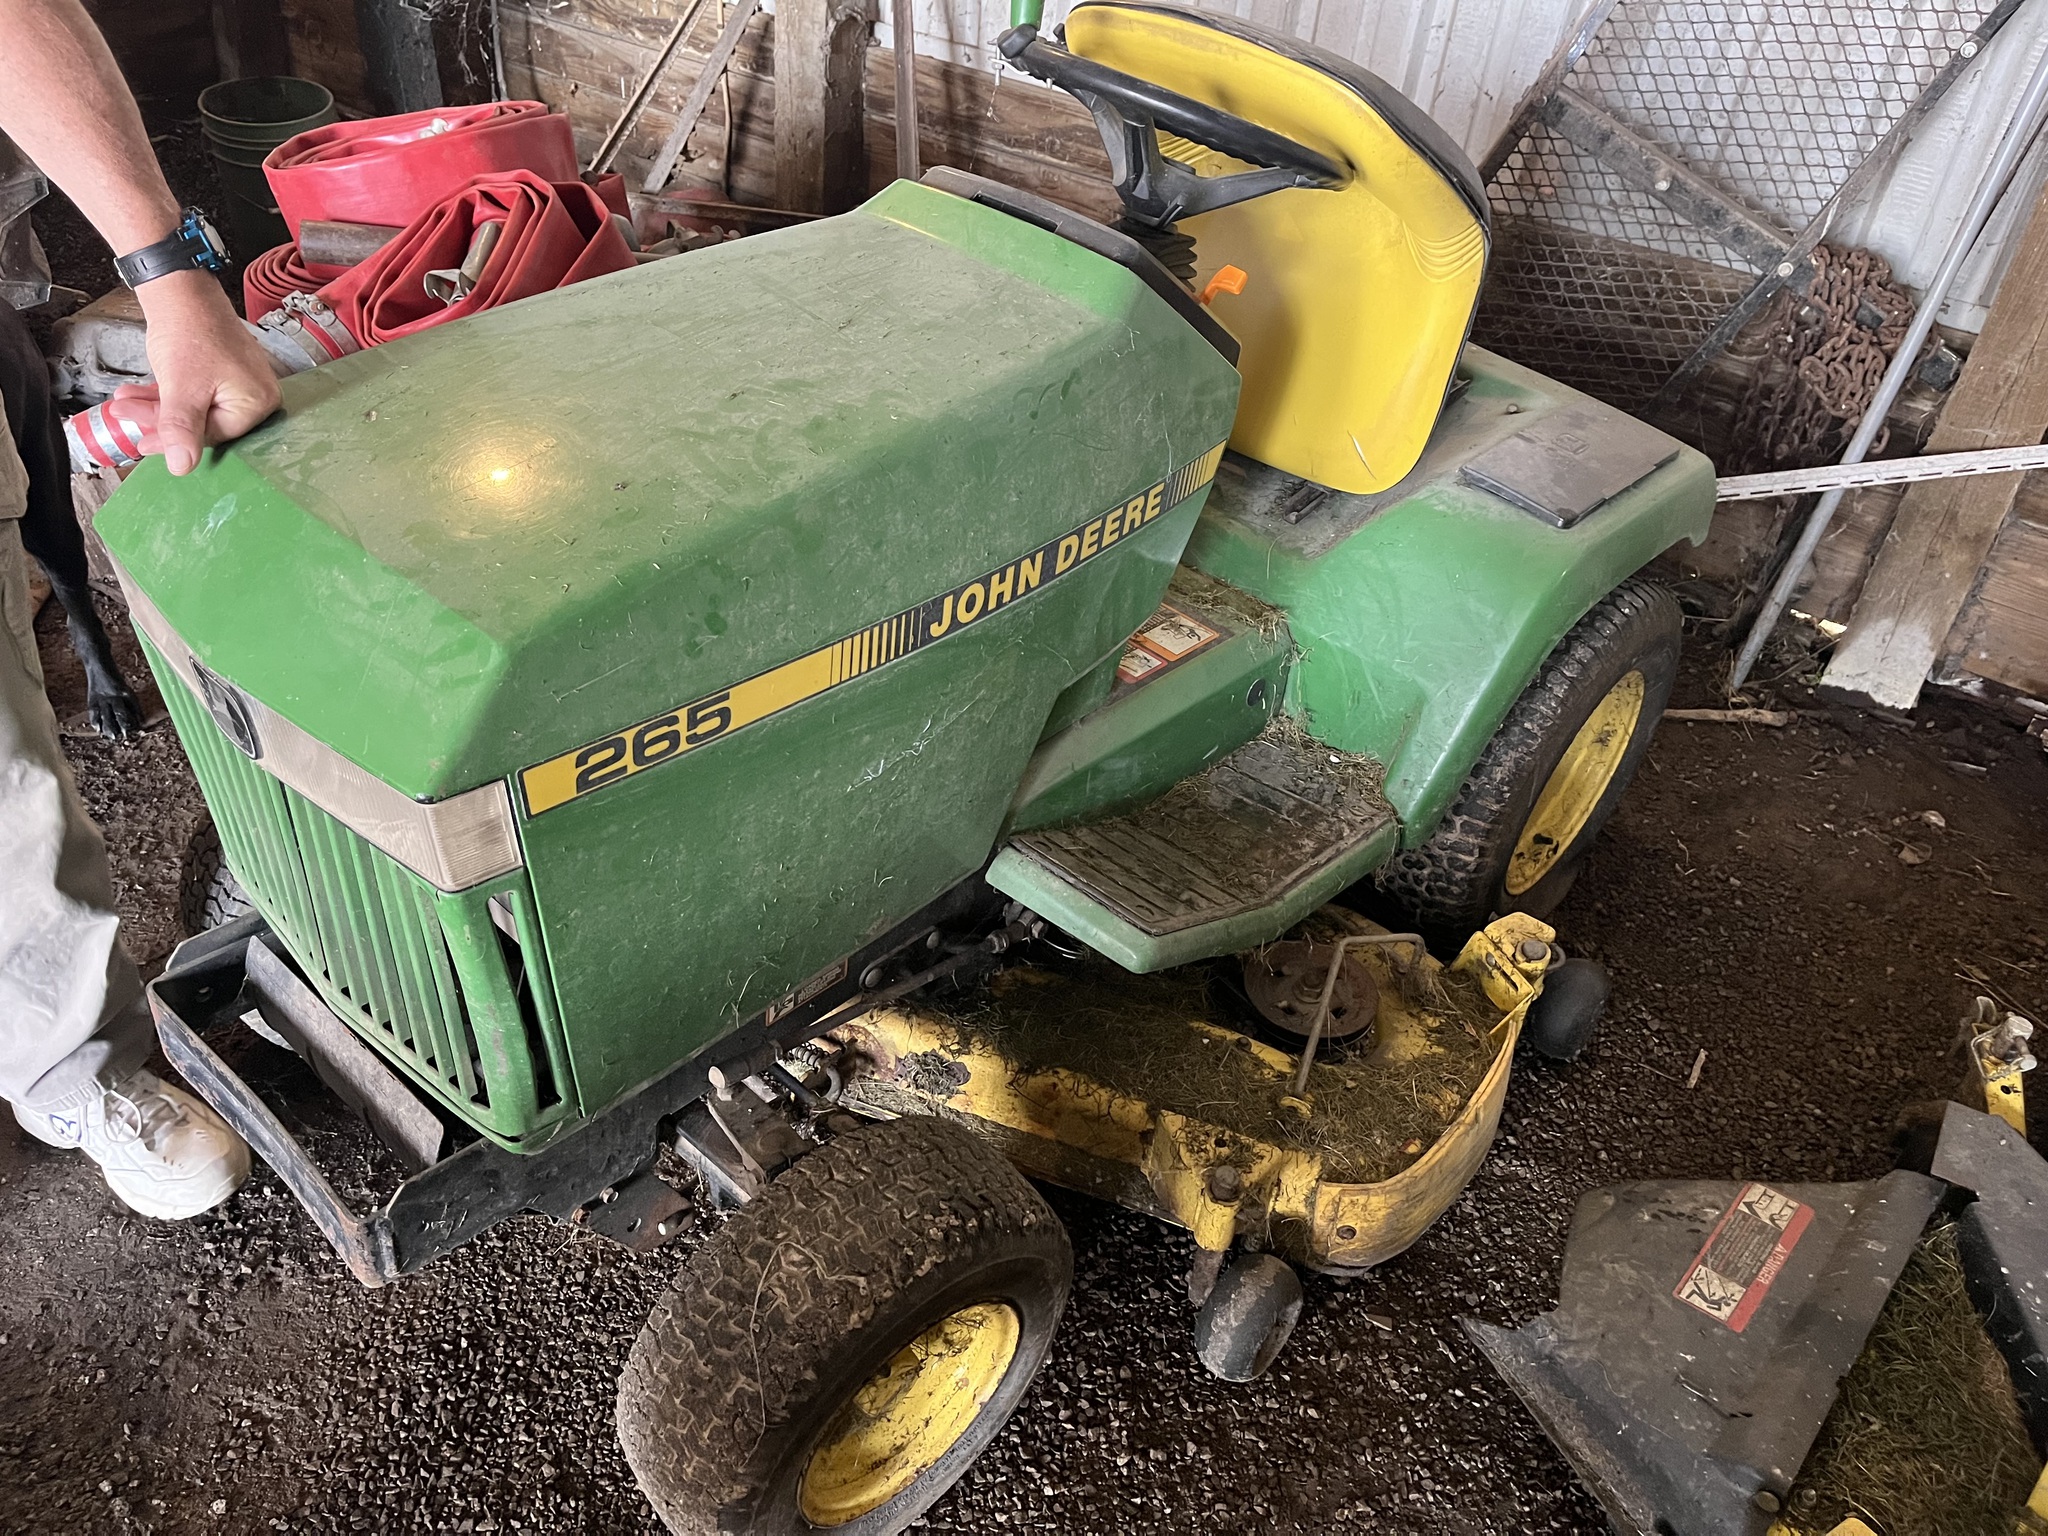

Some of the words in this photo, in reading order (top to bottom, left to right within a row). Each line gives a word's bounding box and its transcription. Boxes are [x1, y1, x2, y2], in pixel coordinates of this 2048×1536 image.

[930, 550, 1044, 637] JOHN
[1055, 482, 1165, 576] DEERE
[575, 691, 732, 795] 265
[1756, 1250, 1785, 1284] DANGER
